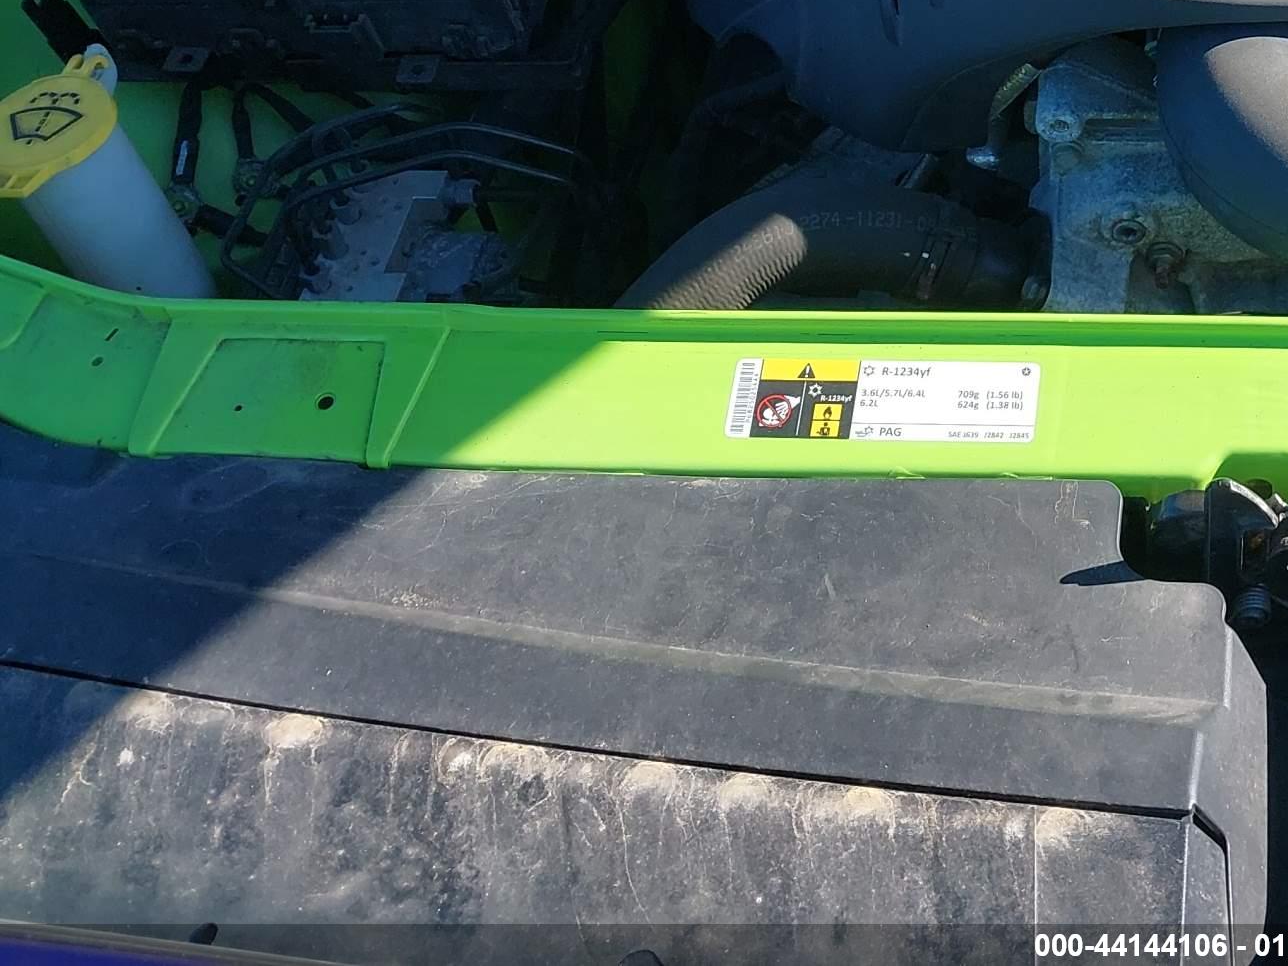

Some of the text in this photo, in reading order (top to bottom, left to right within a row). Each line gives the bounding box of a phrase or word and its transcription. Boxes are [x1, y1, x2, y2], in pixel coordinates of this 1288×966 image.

[881, 367, 931, 378] R-1234yf
[820, 394, 853, 403] R-1234yf
[861, 389, 1024, 400] 3.6L/5.7L/6.4L 709g (1.56 lb)
[859, 399, 1024, 411] 6.2L 624g (1.38 lb)
[879, 427, 902, 437] PAG
